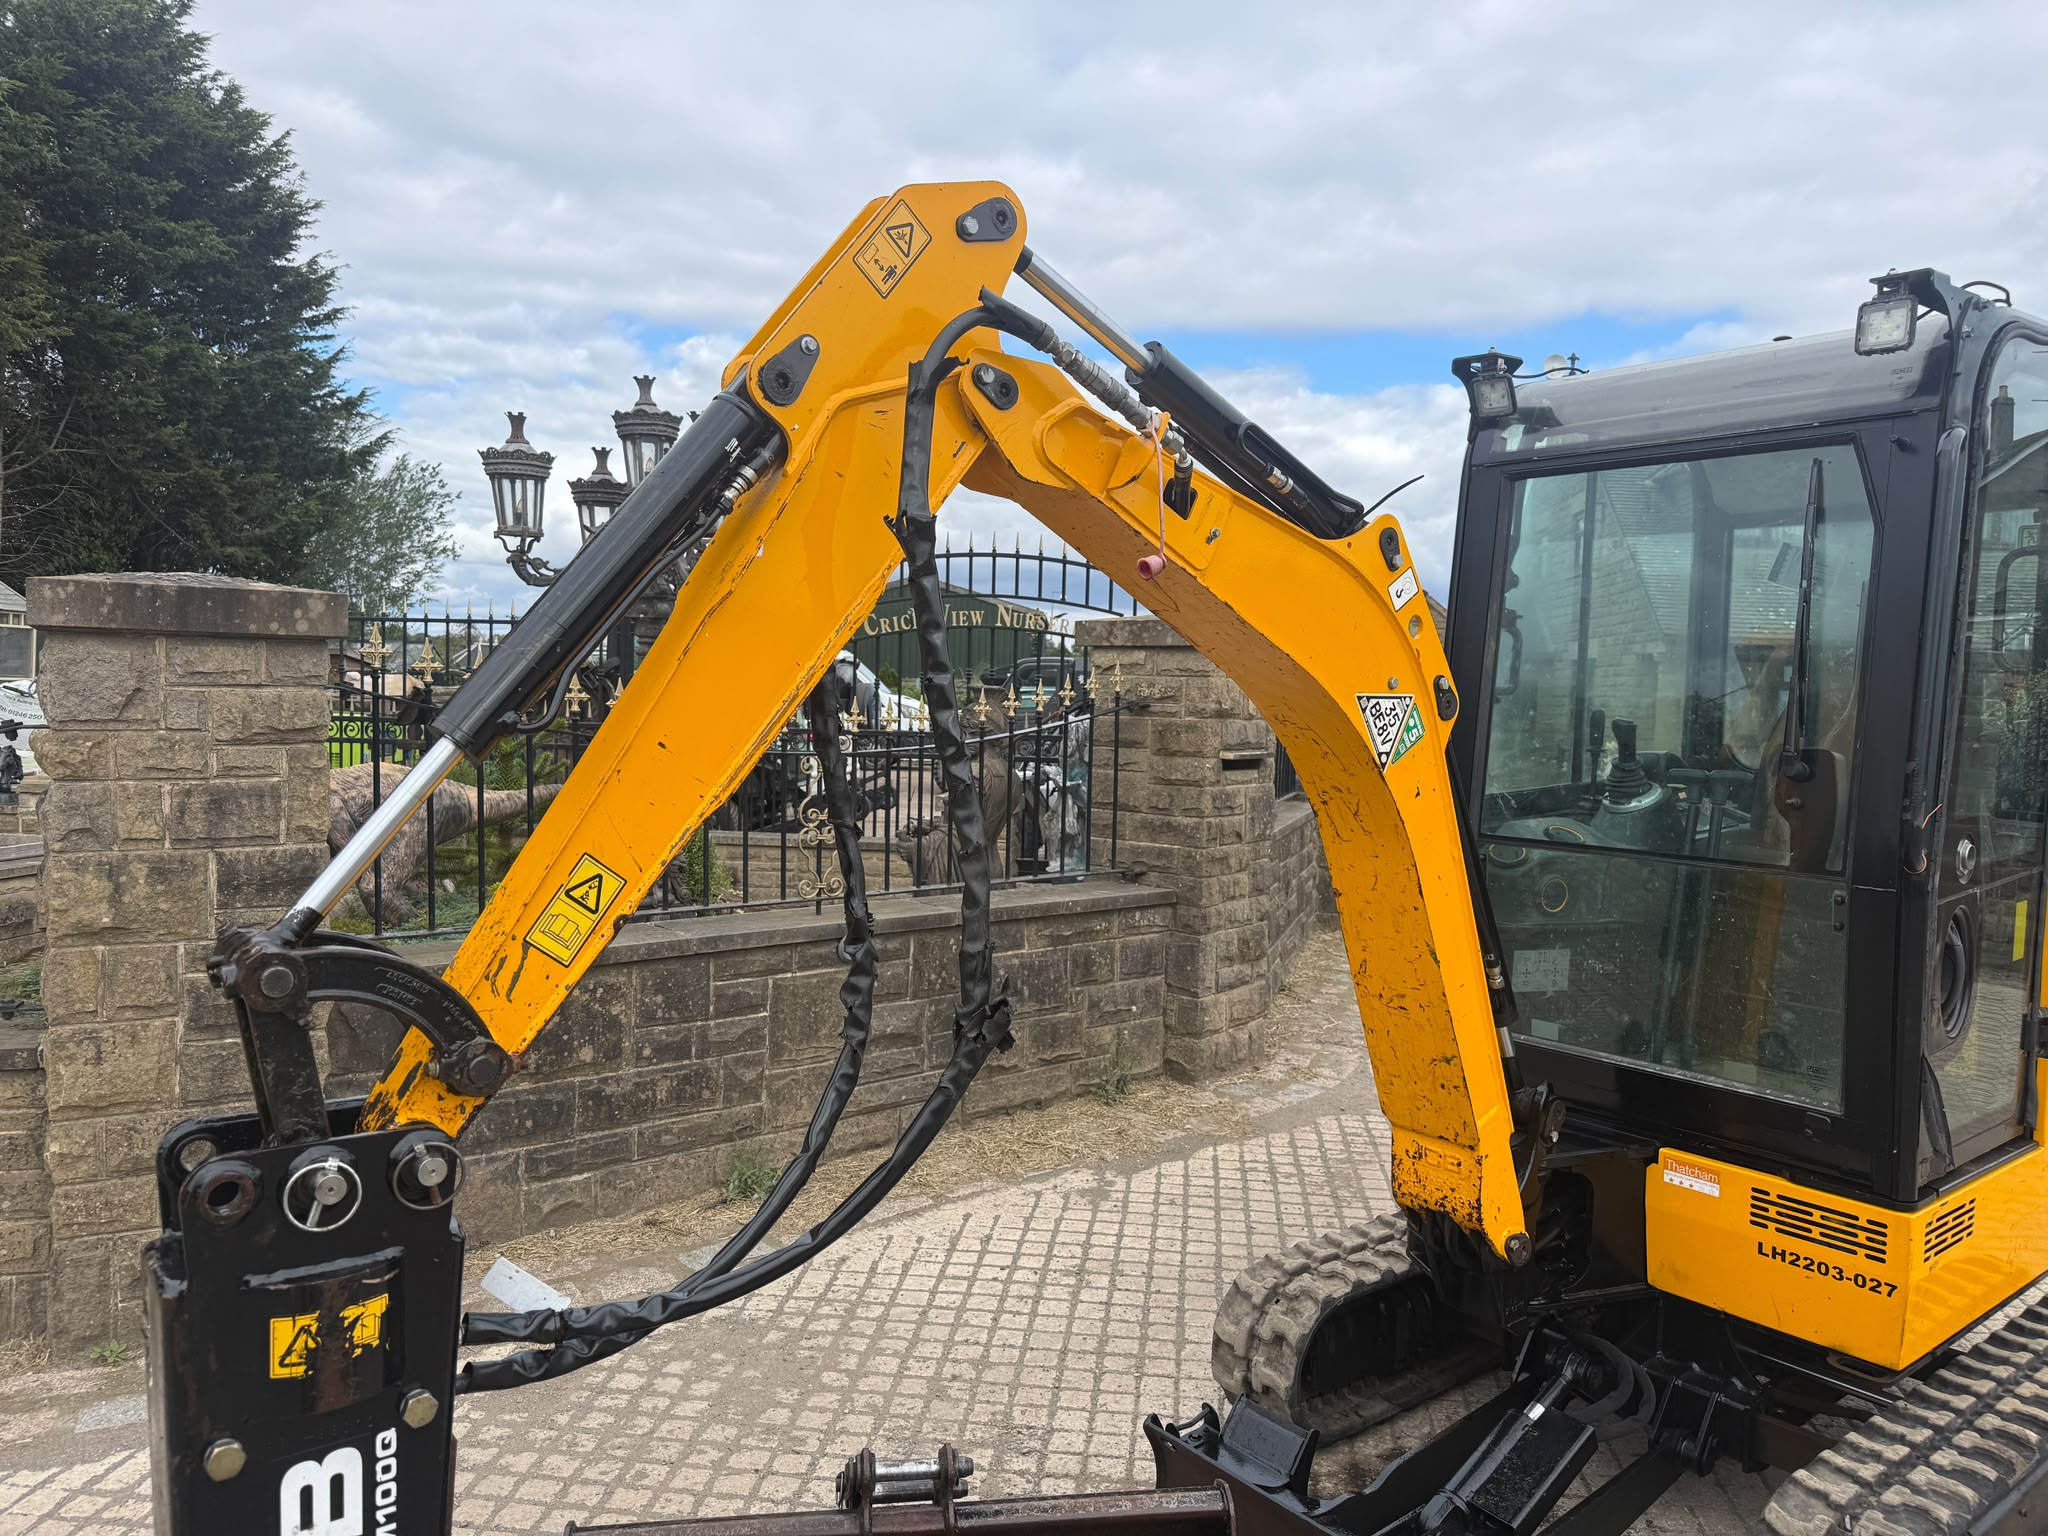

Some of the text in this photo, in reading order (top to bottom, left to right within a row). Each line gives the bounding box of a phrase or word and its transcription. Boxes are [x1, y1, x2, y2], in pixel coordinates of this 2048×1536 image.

[995, 604, 1071, 633] NURSER
[1369, 701, 1393, 746] BE8V
[1384, 702, 1401, 728] 35
[1665, 1158, 1719, 1184] Thatcham
[1757, 1241, 1898, 1298] LH2203-027
